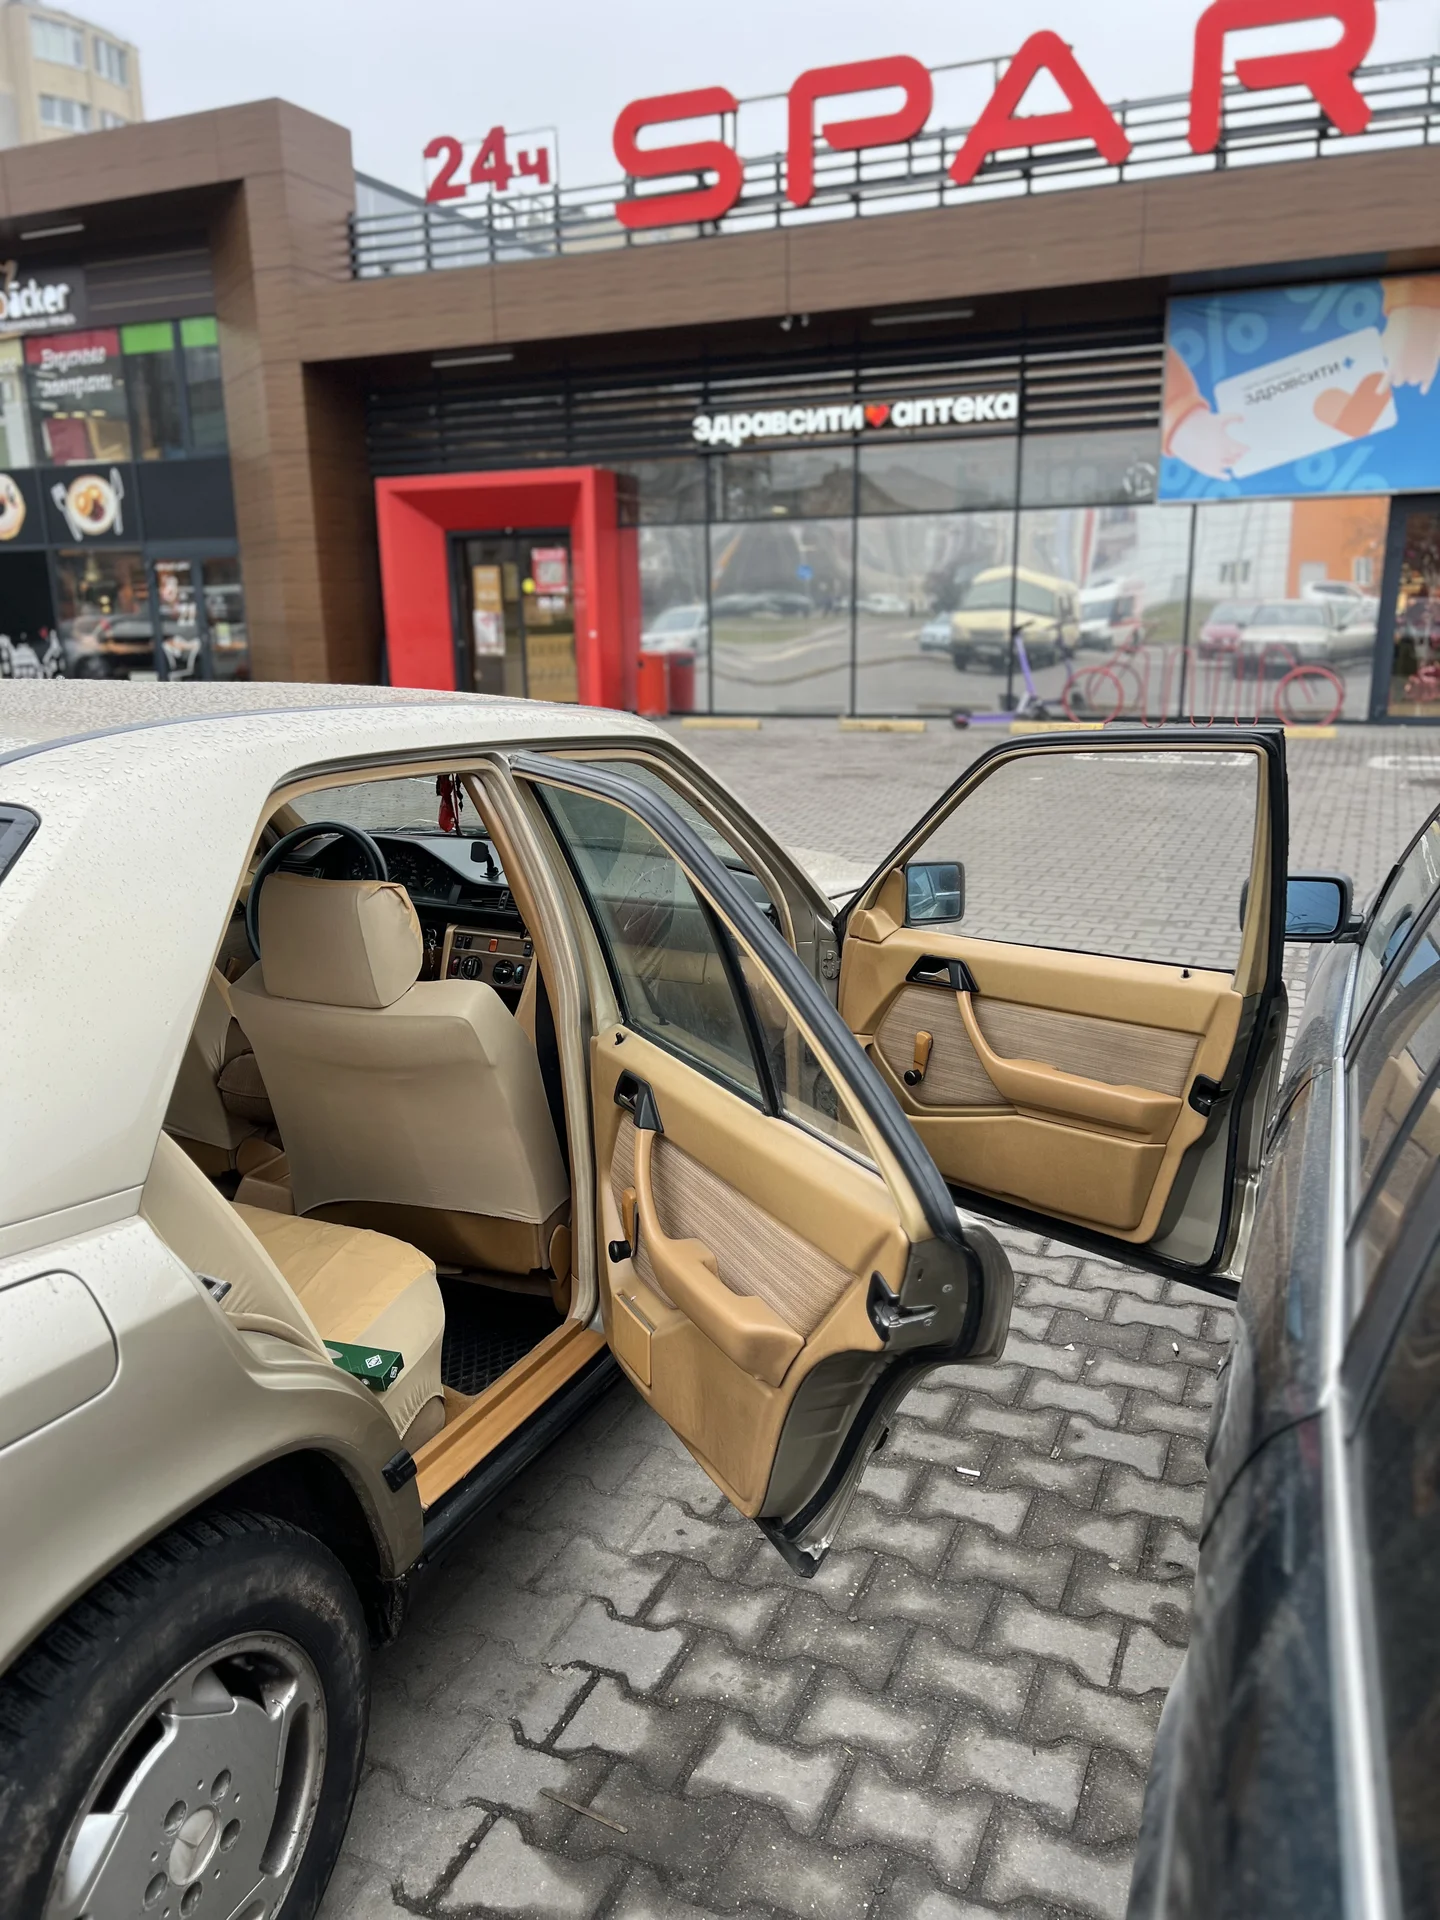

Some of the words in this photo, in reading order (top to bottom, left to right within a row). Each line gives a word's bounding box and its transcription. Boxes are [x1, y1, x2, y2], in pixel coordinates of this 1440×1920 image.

[612, 0, 1377, 230] SPAR
[424, 126, 550, 204] 24ч
[0, 278, 70, 318] icker
[692, 404, 864, 447] здравсити
[891, 392, 1019, 428] аптека
